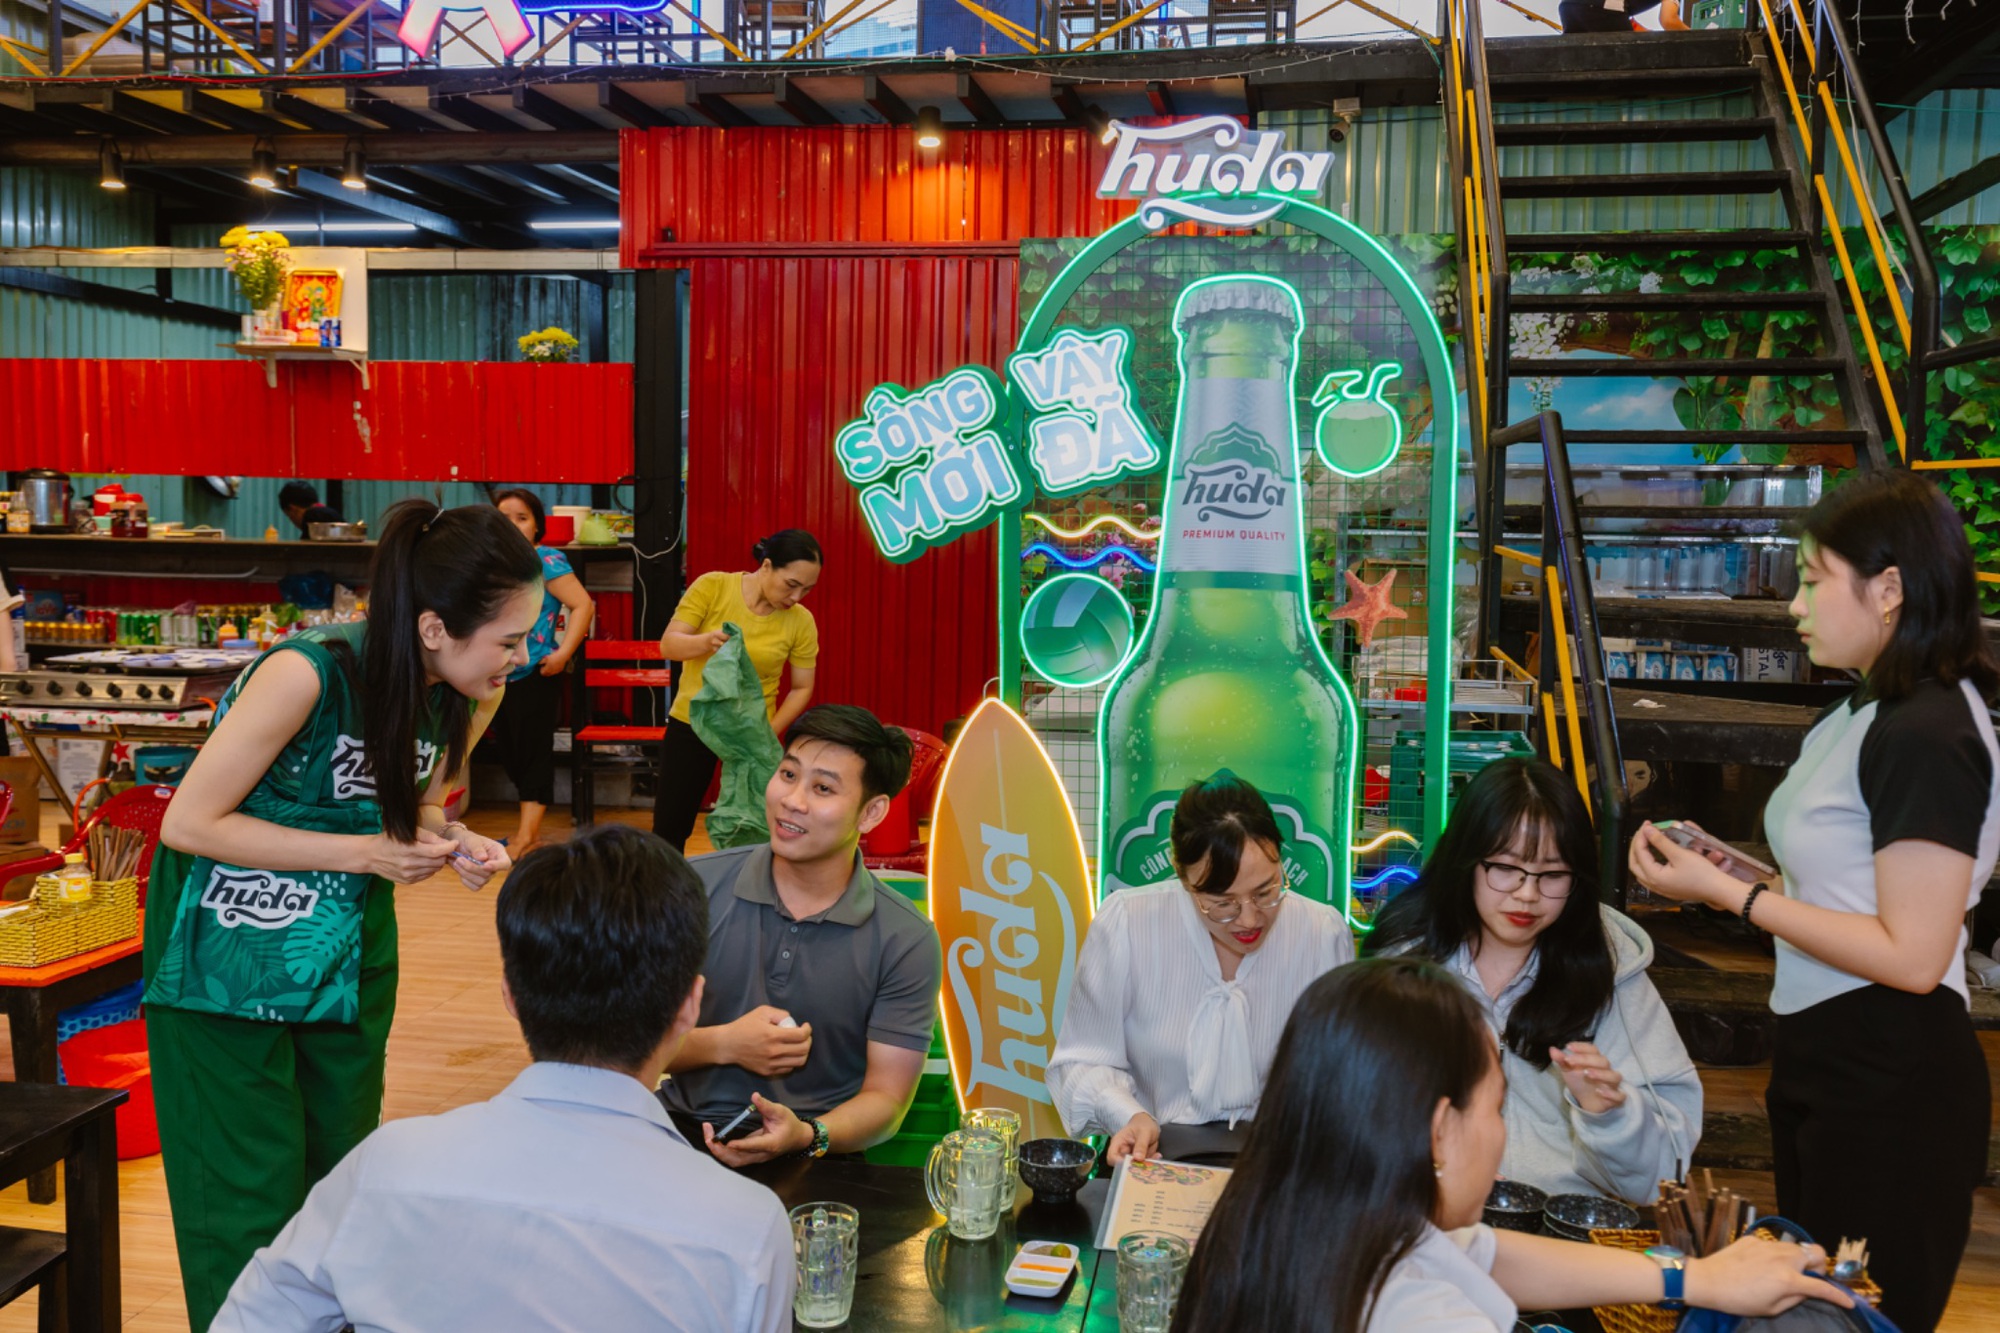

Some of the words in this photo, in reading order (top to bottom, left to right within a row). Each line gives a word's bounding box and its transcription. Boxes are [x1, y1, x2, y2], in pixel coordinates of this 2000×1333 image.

[1100, 116, 1330, 229] huda
[844, 380, 985, 474] SỐNG
[867, 440, 1012, 548] MỚI
[1038, 391, 1150, 481] ĐÃ
[1182, 465, 1286, 522] huda
[1183, 530, 1235, 539] PREMIUM
[1240, 530, 1286, 541] QUALITY
[207, 870, 313, 922] huda
[948, 823, 1076, 1105] huda
